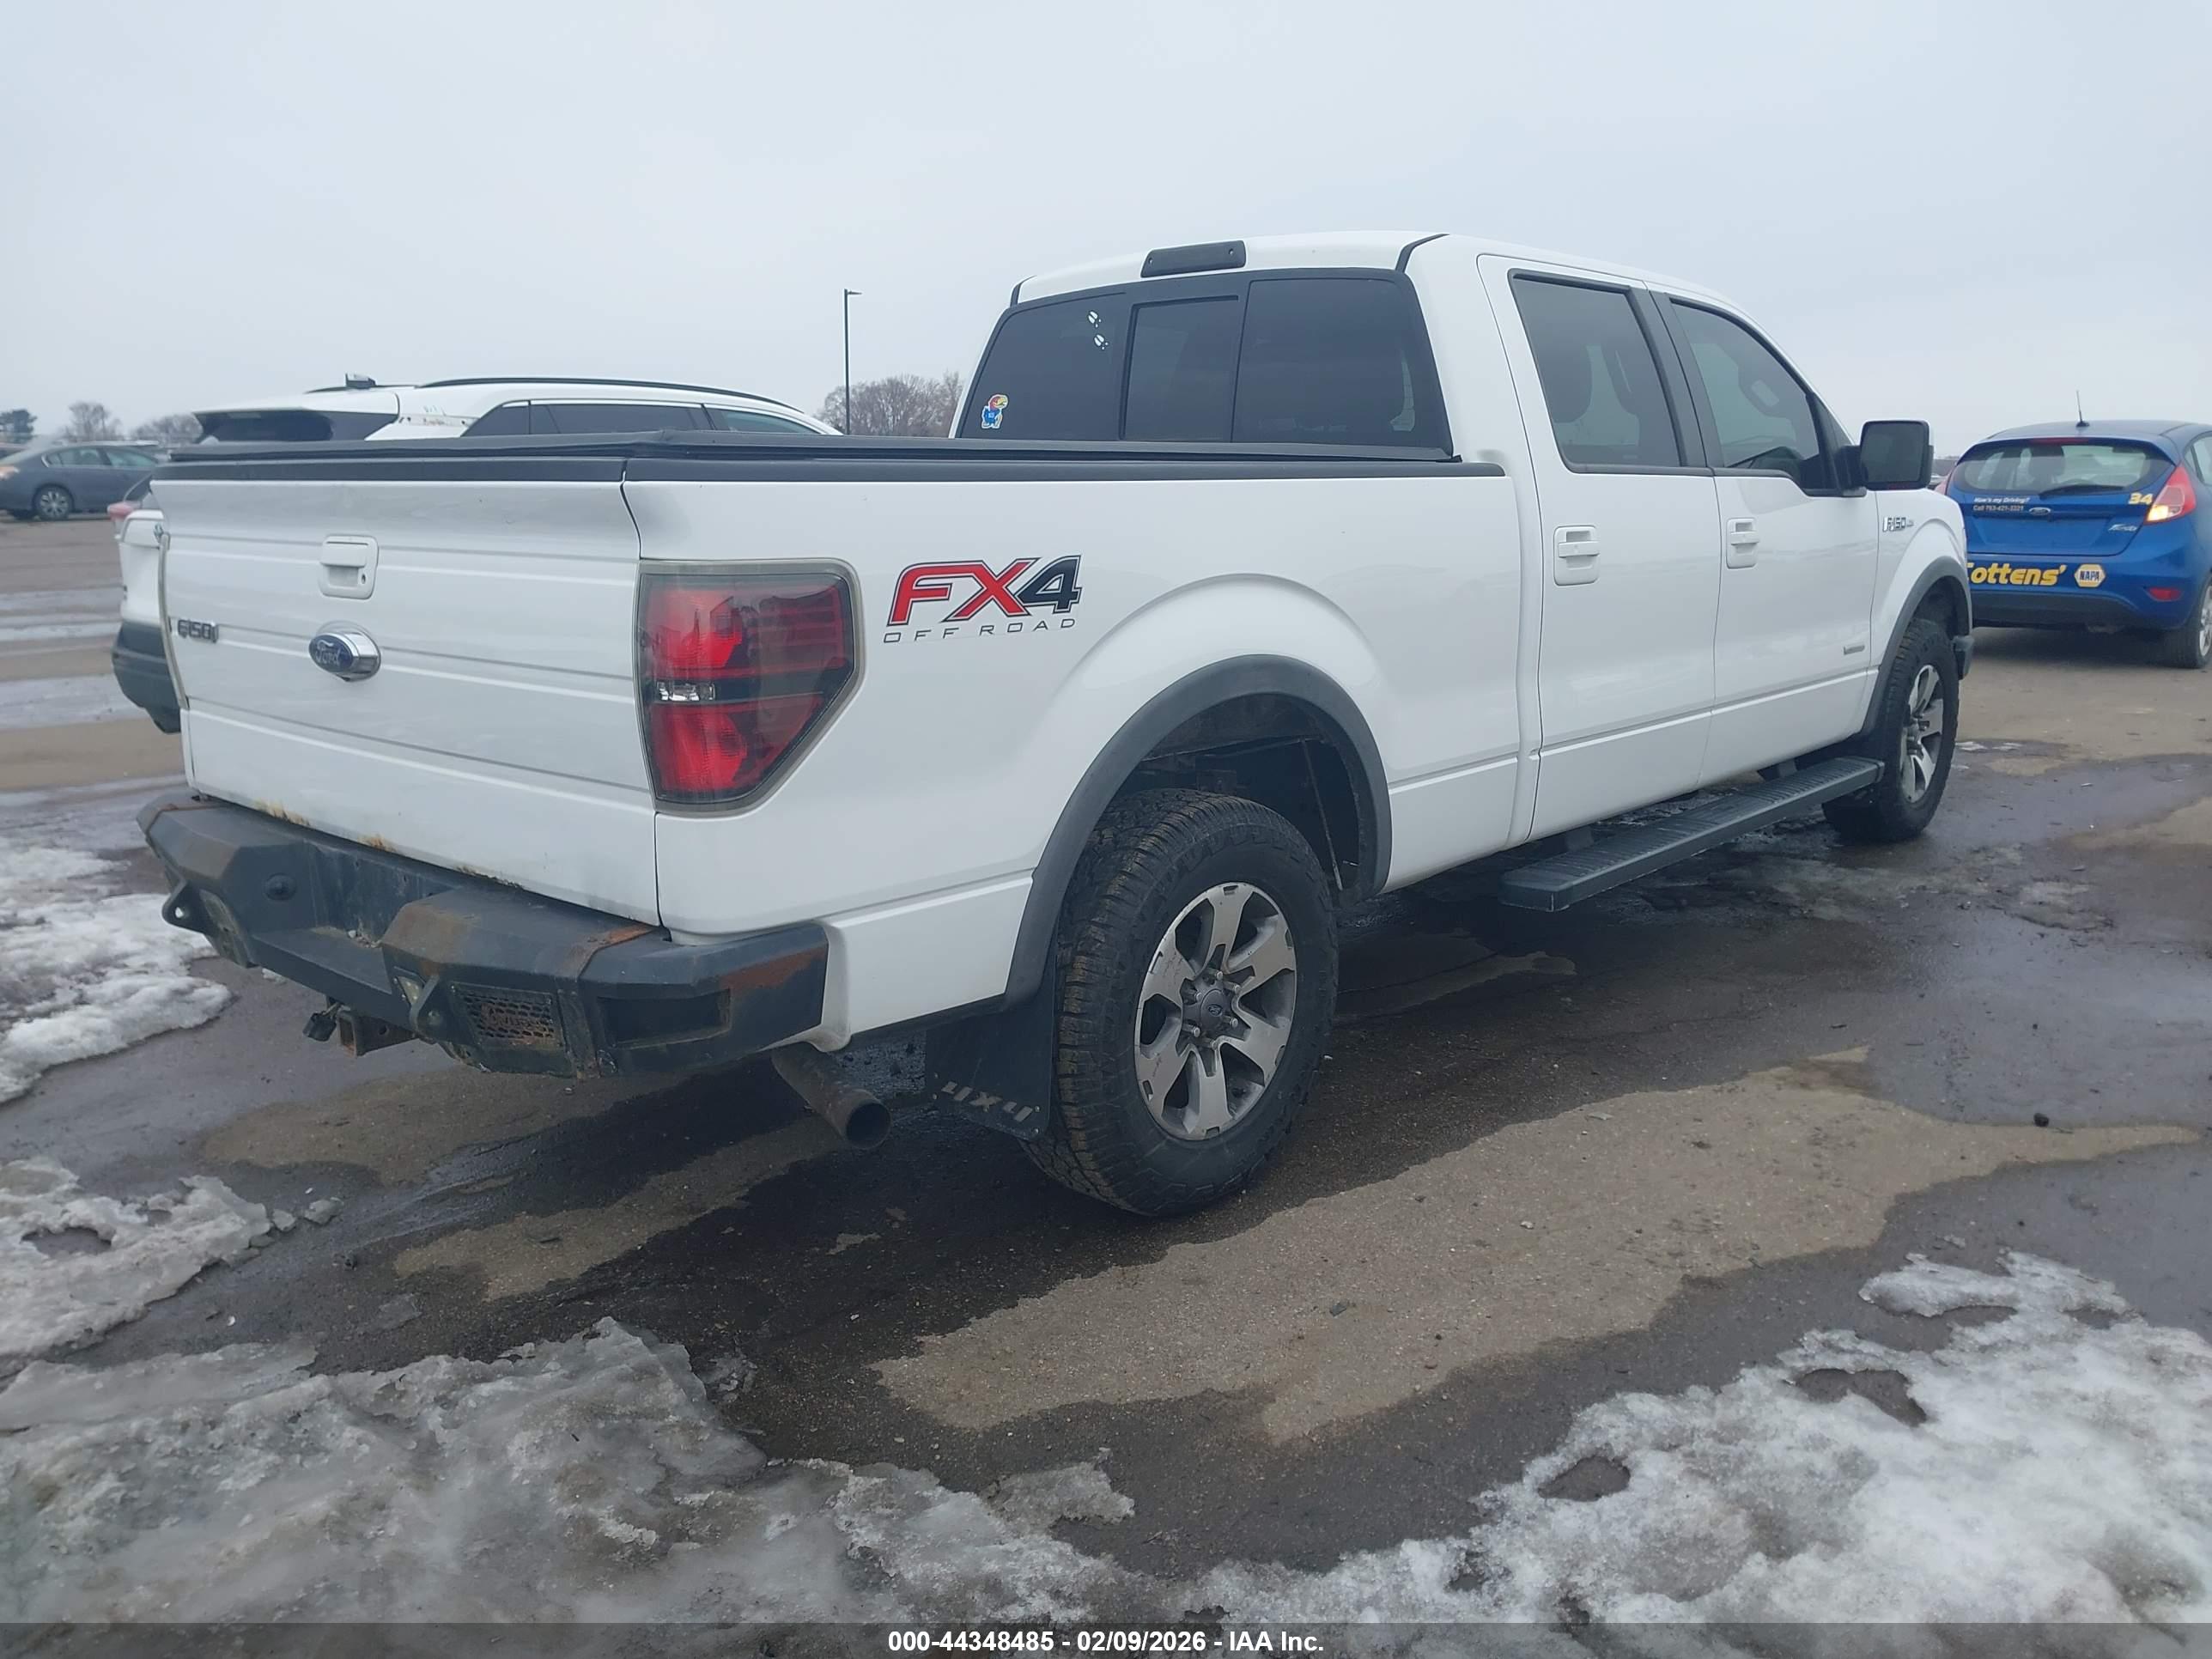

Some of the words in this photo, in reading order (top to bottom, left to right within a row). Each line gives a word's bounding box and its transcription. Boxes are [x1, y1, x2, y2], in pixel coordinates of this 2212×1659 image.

[2128, 492, 2154, 505] 34
[1966, 562, 2068, 586] ottens'
[2078, 570, 2100, 582] NAPA
[887, 554, 1083, 627] FX4
[883, 627, 960, 643] OFF
[979, 618, 1076, 636] ROAD
[315, 639, 342, 666] Ford
